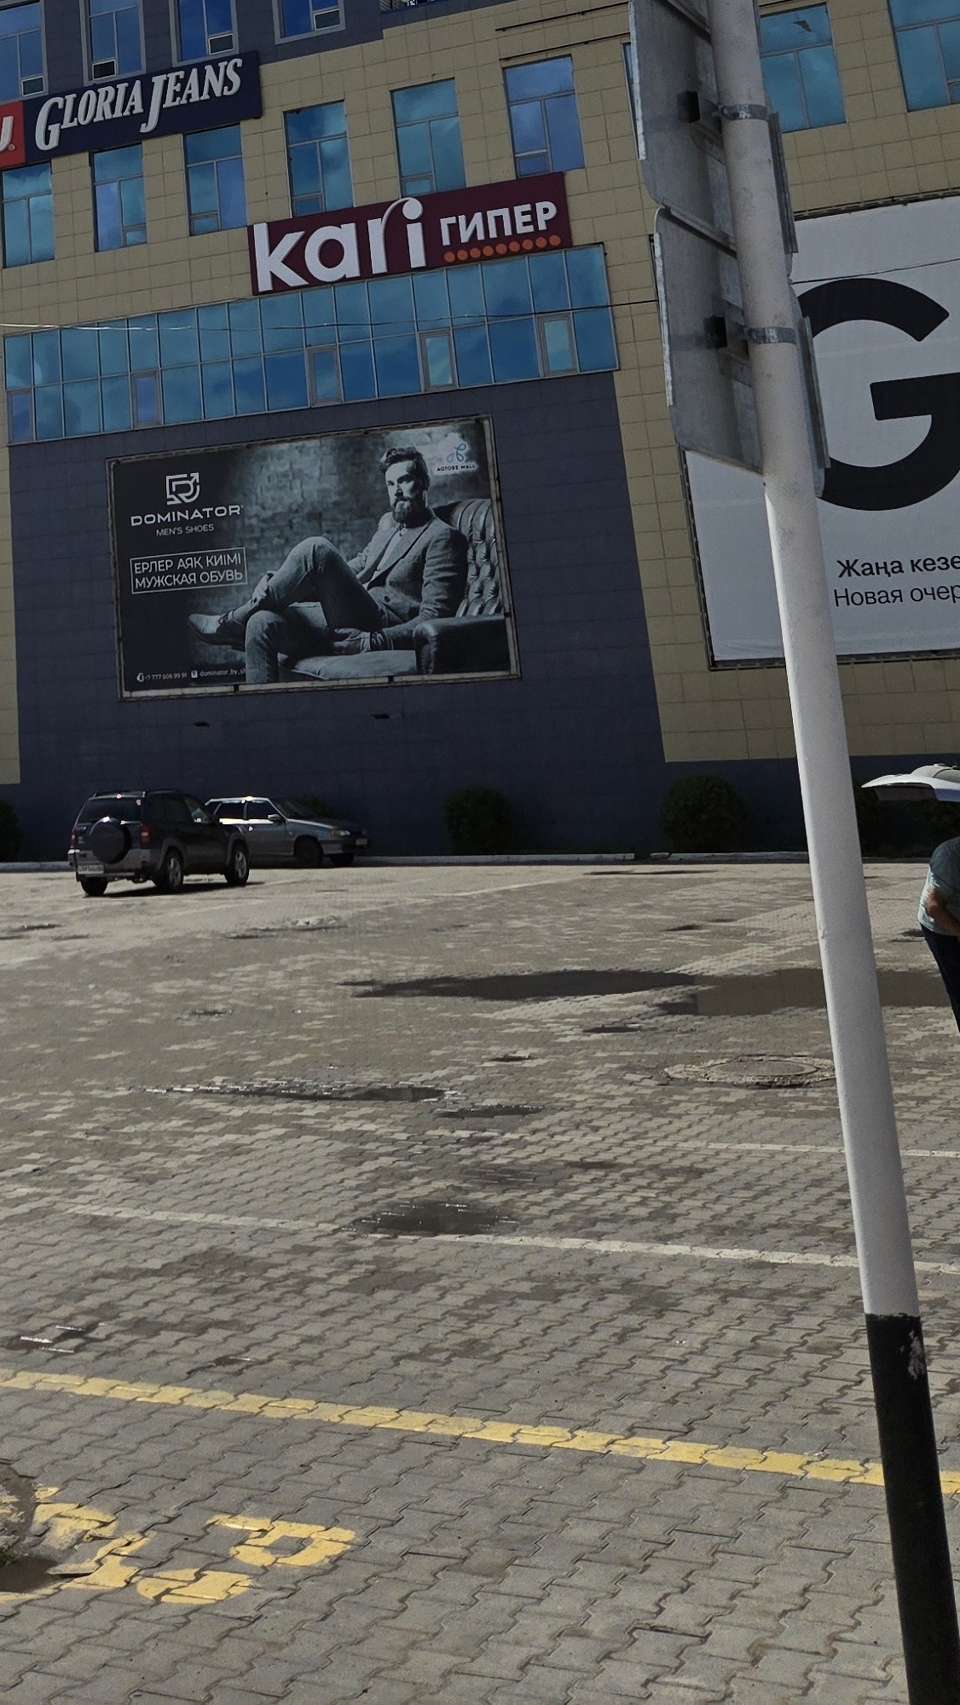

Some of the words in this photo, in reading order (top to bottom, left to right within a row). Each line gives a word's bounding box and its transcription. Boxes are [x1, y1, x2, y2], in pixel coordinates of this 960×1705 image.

[35, 79, 144, 151] GLORIA
[140, 58, 243, 133] JEANS
[440, 200, 558, 246] ГИПЕР
[253, 196, 427, 293] kari
[130, 504, 241, 527] DOMINATOR
[155, 526, 183, 537] MEN'S
[185, 523, 215, 534] SHOES
[134, 559, 174, 575] ЕРЛЕР
[177, 555, 204, 570] АЯҚ
[206, 552, 241, 568] КИІМІ
[836, 558, 905, 578] Жаңа
[135, 572, 197, 589] МУЖСКАЯ
[200, 569, 243, 583] ОБУВЬ
[833, 587, 904, 608] Новая
